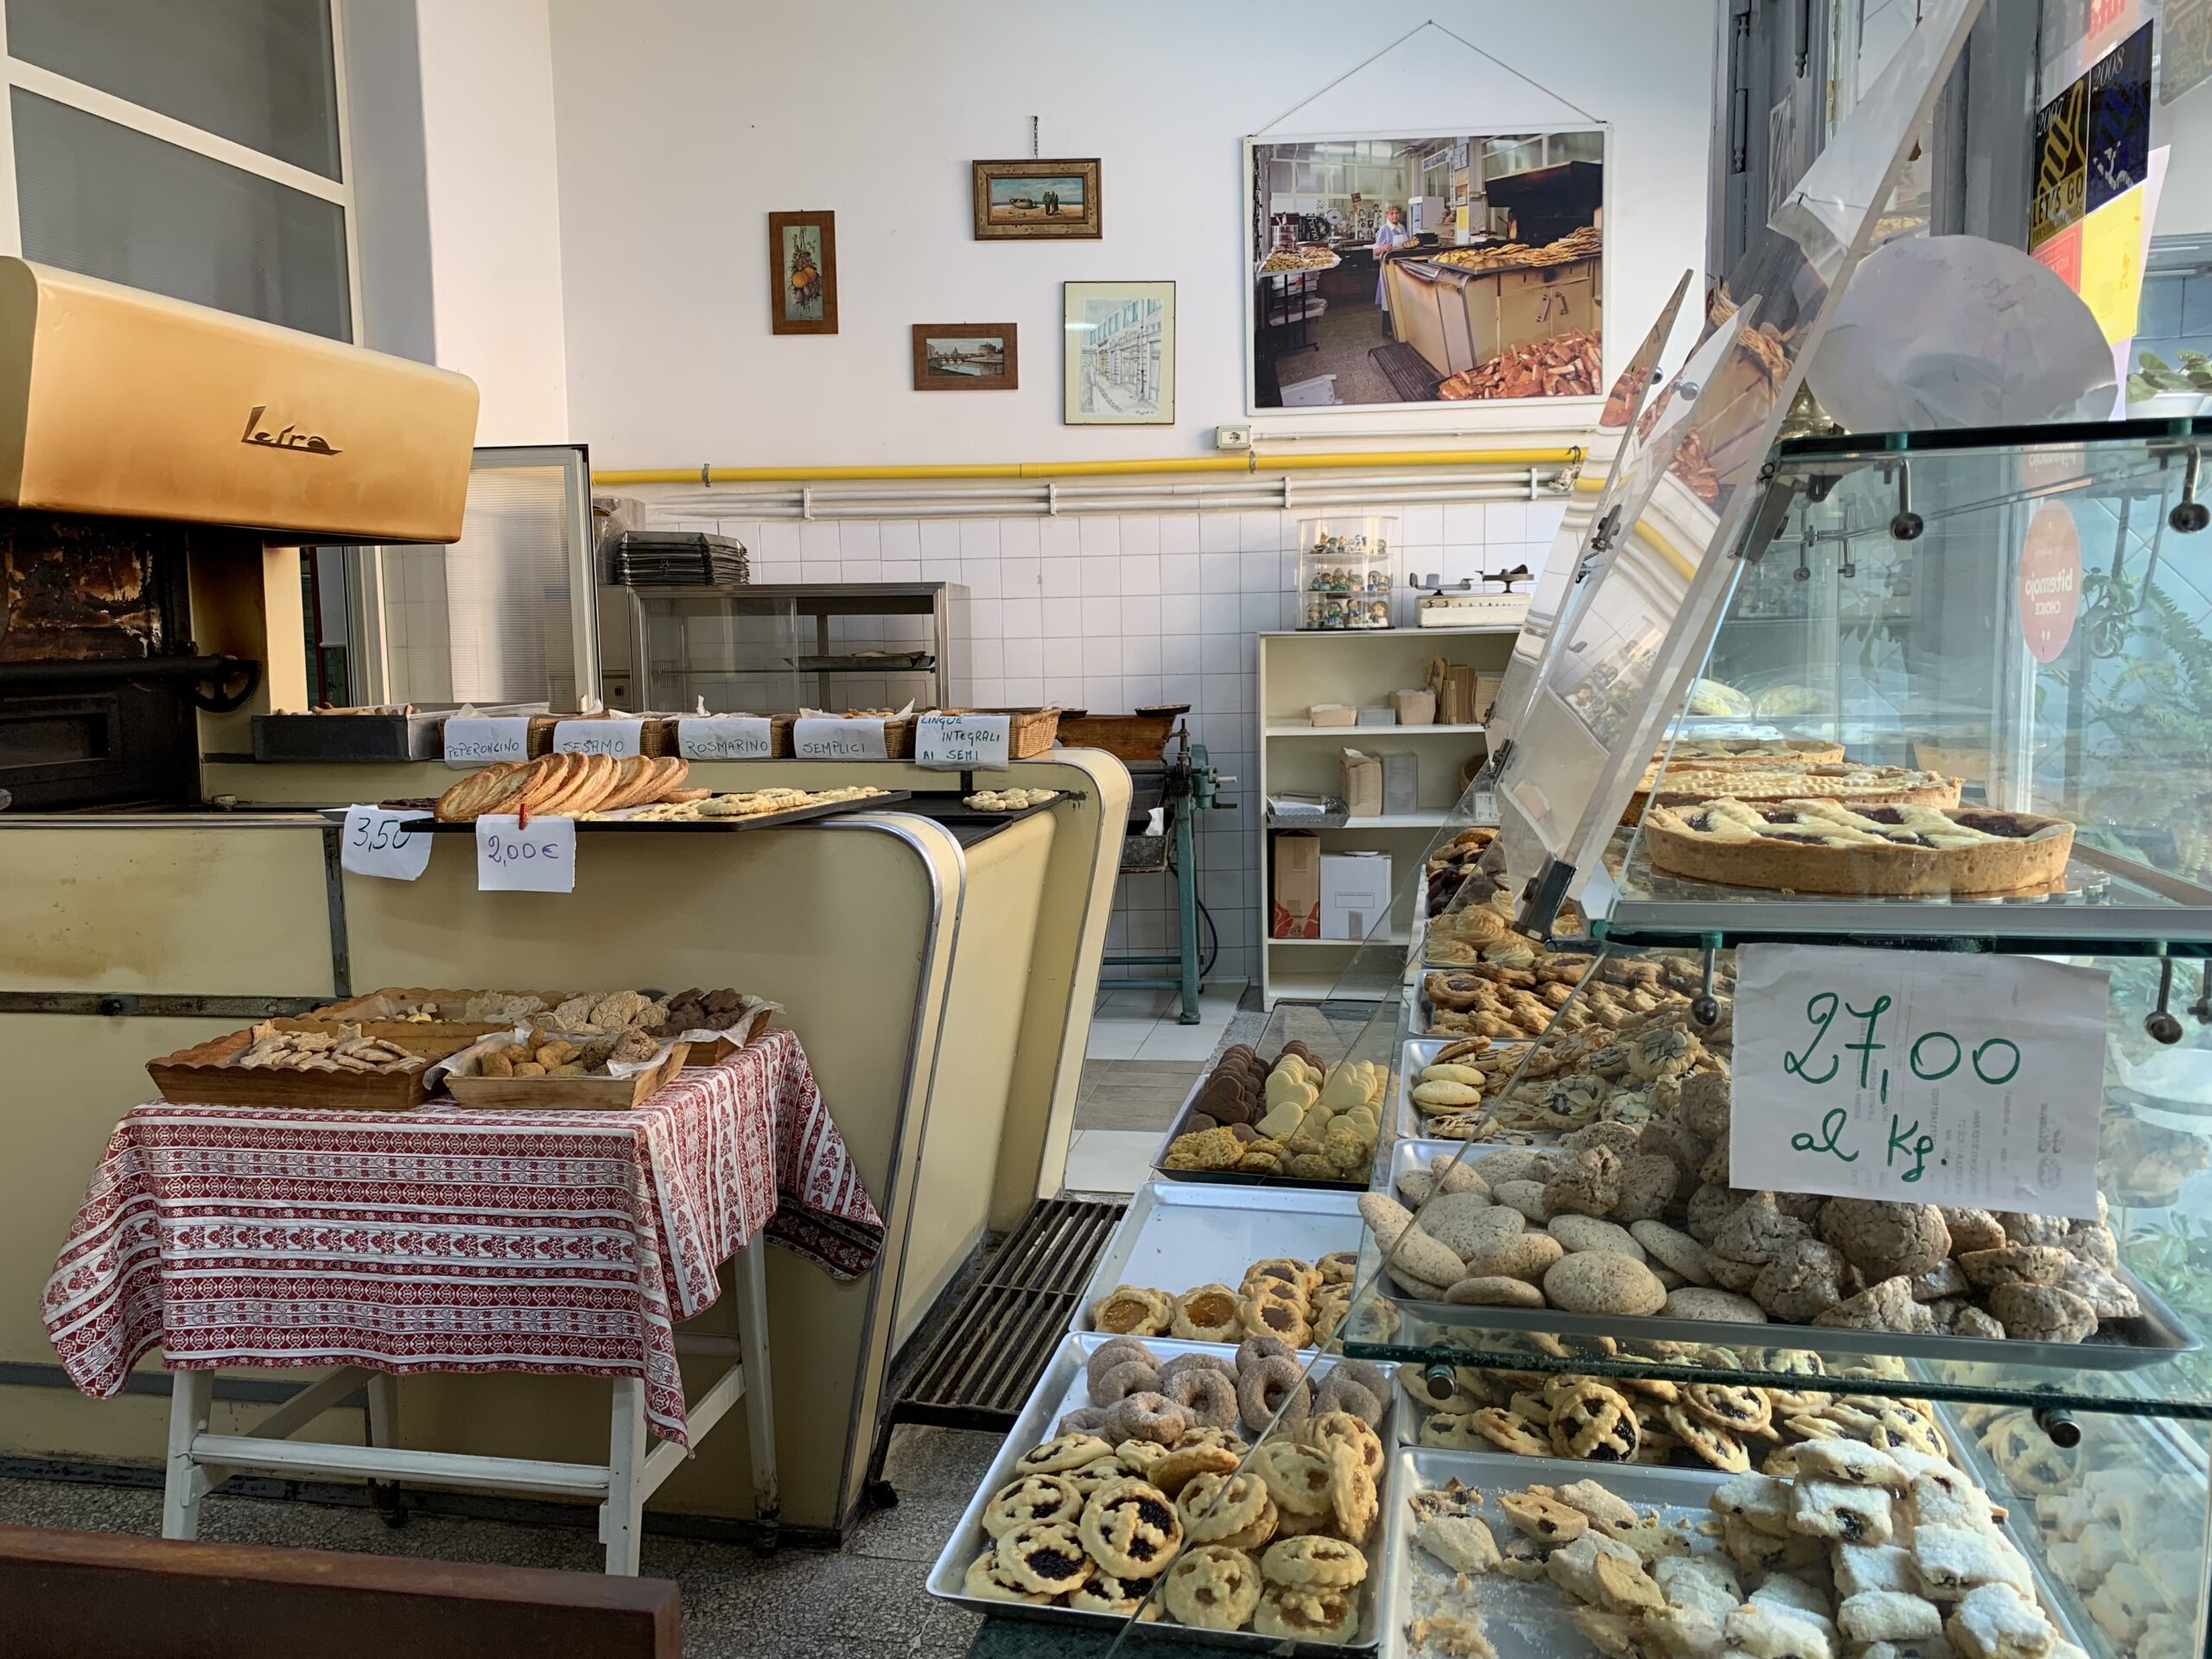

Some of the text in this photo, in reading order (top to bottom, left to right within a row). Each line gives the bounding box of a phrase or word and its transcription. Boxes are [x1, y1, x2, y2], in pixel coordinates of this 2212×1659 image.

[2092, 47, 2125, 93] 2008
[2036, 93, 2066, 138] 2007
[2067, 172, 2084, 206] GO
[921, 717, 963, 730] LINGUE
[446, 738, 519, 759] PEPERONCINO
[563, 740, 625, 754] SESAMO
[685, 740, 768, 756] ROSMARINO
[803, 741, 865, 756] SEMPLICI
[942, 730, 1001, 747] INTEGRALI
[923, 750, 978, 760] AI SEMI
[353, 817, 412, 853] 3,50
[1783, 992, 2021, 1105] 27,00
[1790, 1108, 1859, 1163] al
